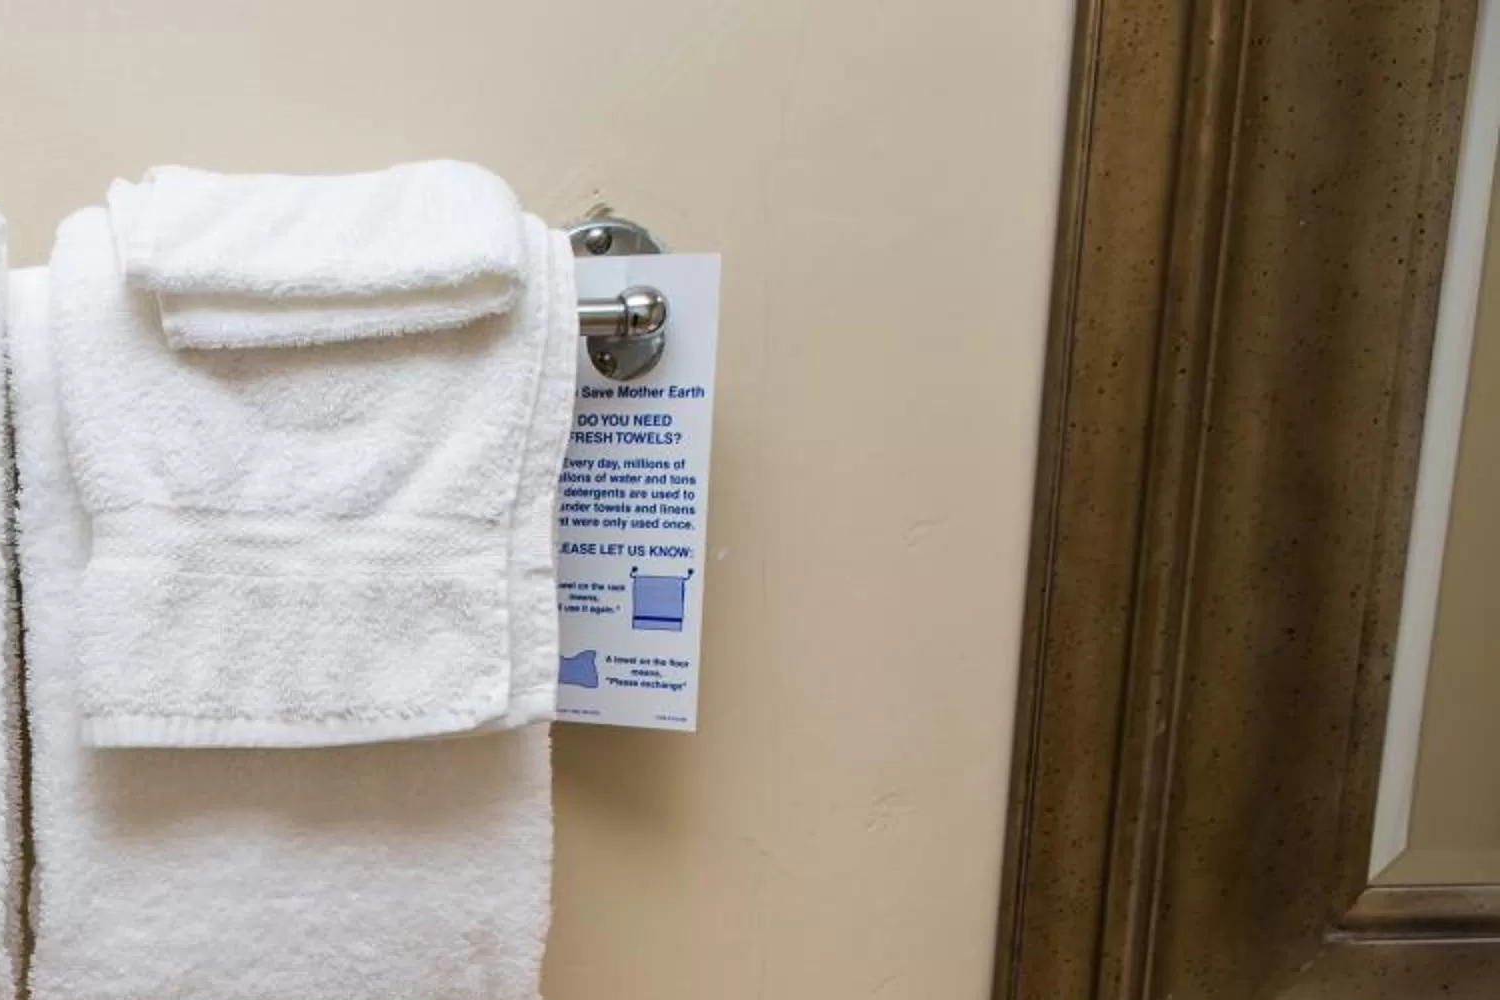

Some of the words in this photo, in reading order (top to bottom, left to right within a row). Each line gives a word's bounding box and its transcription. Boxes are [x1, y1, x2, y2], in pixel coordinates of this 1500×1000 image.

[582, 385, 614, 398] Save
[617, 385, 664, 398] Mother
[668, 385, 705, 399] Earth
[578, 414, 598, 427] DO
[601, 414, 630, 427] YOU
[633, 414, 673, 427] NEED
[616, 432, 682, 445] TOWELS?
[623, 459, 671, 469] millions
[673, 459, 685, 470] of
[595, 472, 606, 483] of
[610, 474, 642, 484] water
[644, 475, 667, 485] and
[669, 475, 696, 485] tons
[563, 487, 625, 500] detergents
[629, 489, 648, 499] are
[651, 489, 680, 500] used
[683, 489, 696, 501] to
[593, 501, 631, 513] towels
[634, 503, 657, 514] and
[660, 504, 696, 515] linens
[572, 518, 600, 527] were
[602, 516, 627, 530] only
[631, 517, 659, 529] used
[560, 543, 597, 555] EASE
[600, 544, 625, 555] LET
[627, 545, 645, 557] US
[649, 546, 693, 558] KNOW:
